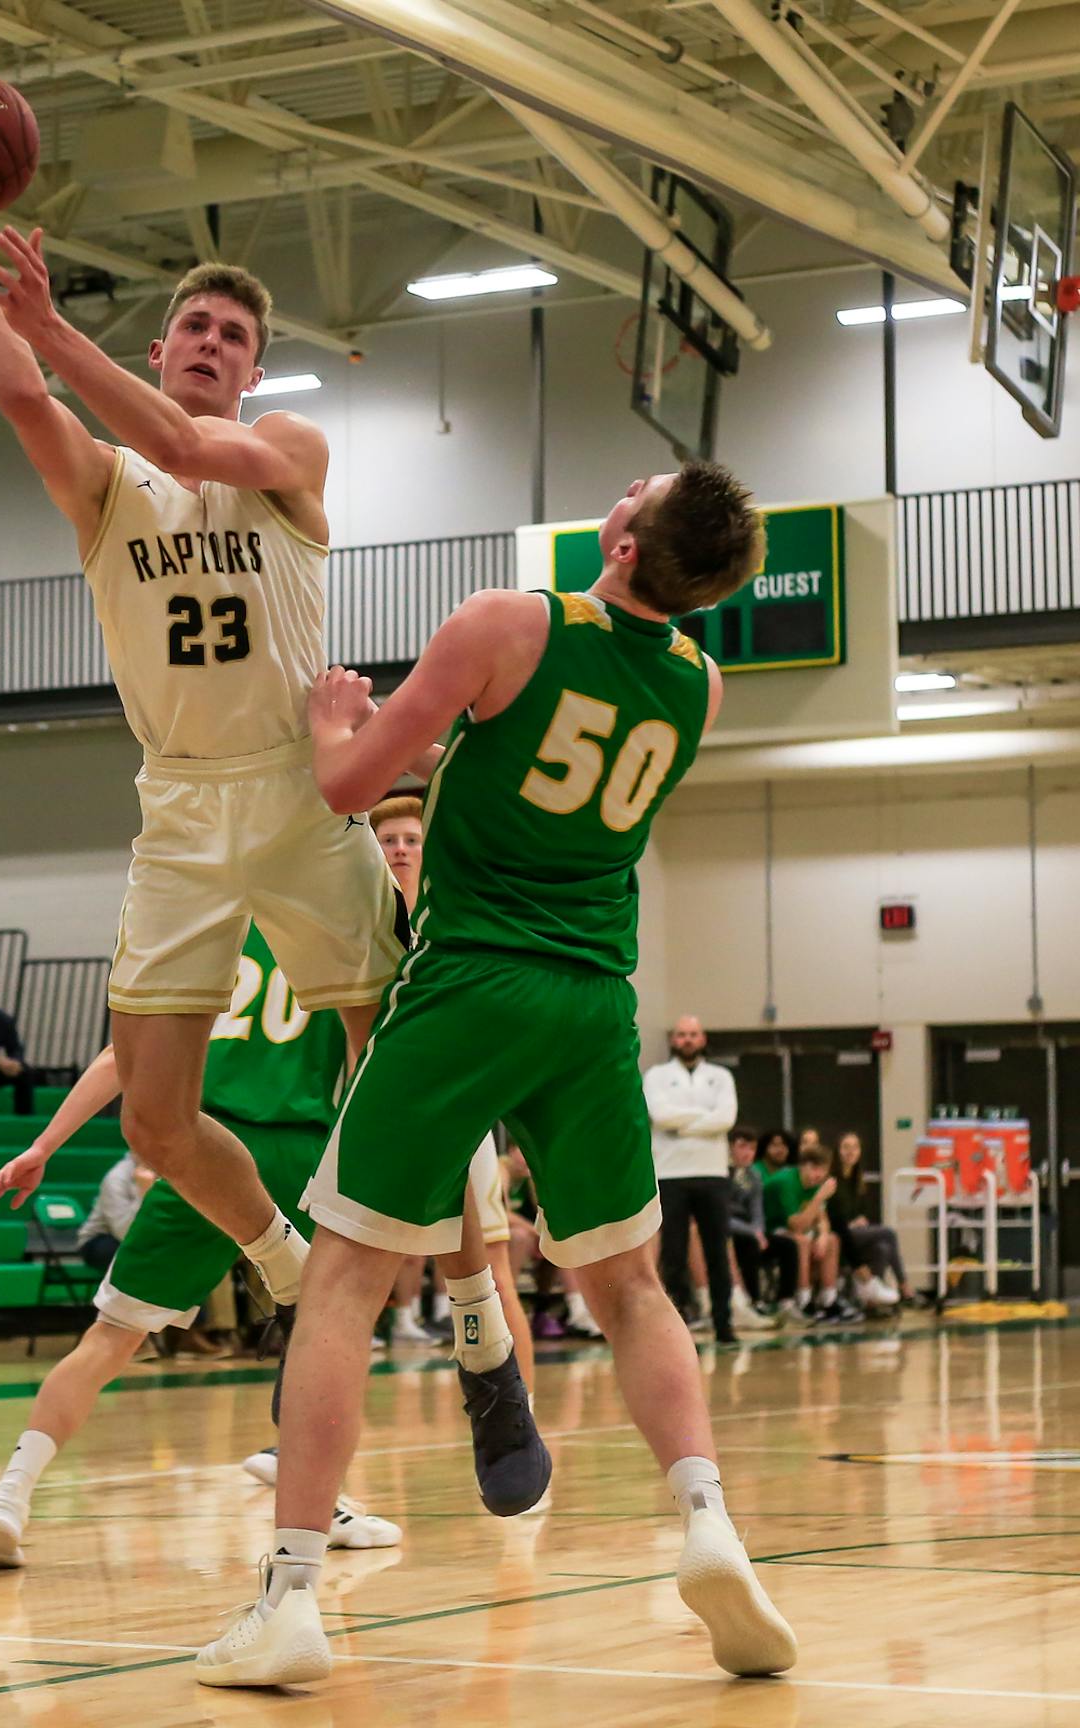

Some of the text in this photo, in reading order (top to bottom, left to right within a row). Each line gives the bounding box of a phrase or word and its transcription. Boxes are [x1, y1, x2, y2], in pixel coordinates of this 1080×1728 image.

[127, 530, 263, 582] RAPTORS
[753, 570, 823, 600] GUEST
[167, 595, 251, 665] 23
[519, 688, 679, 832] 50
[208, 954, 312, 1044] 20
